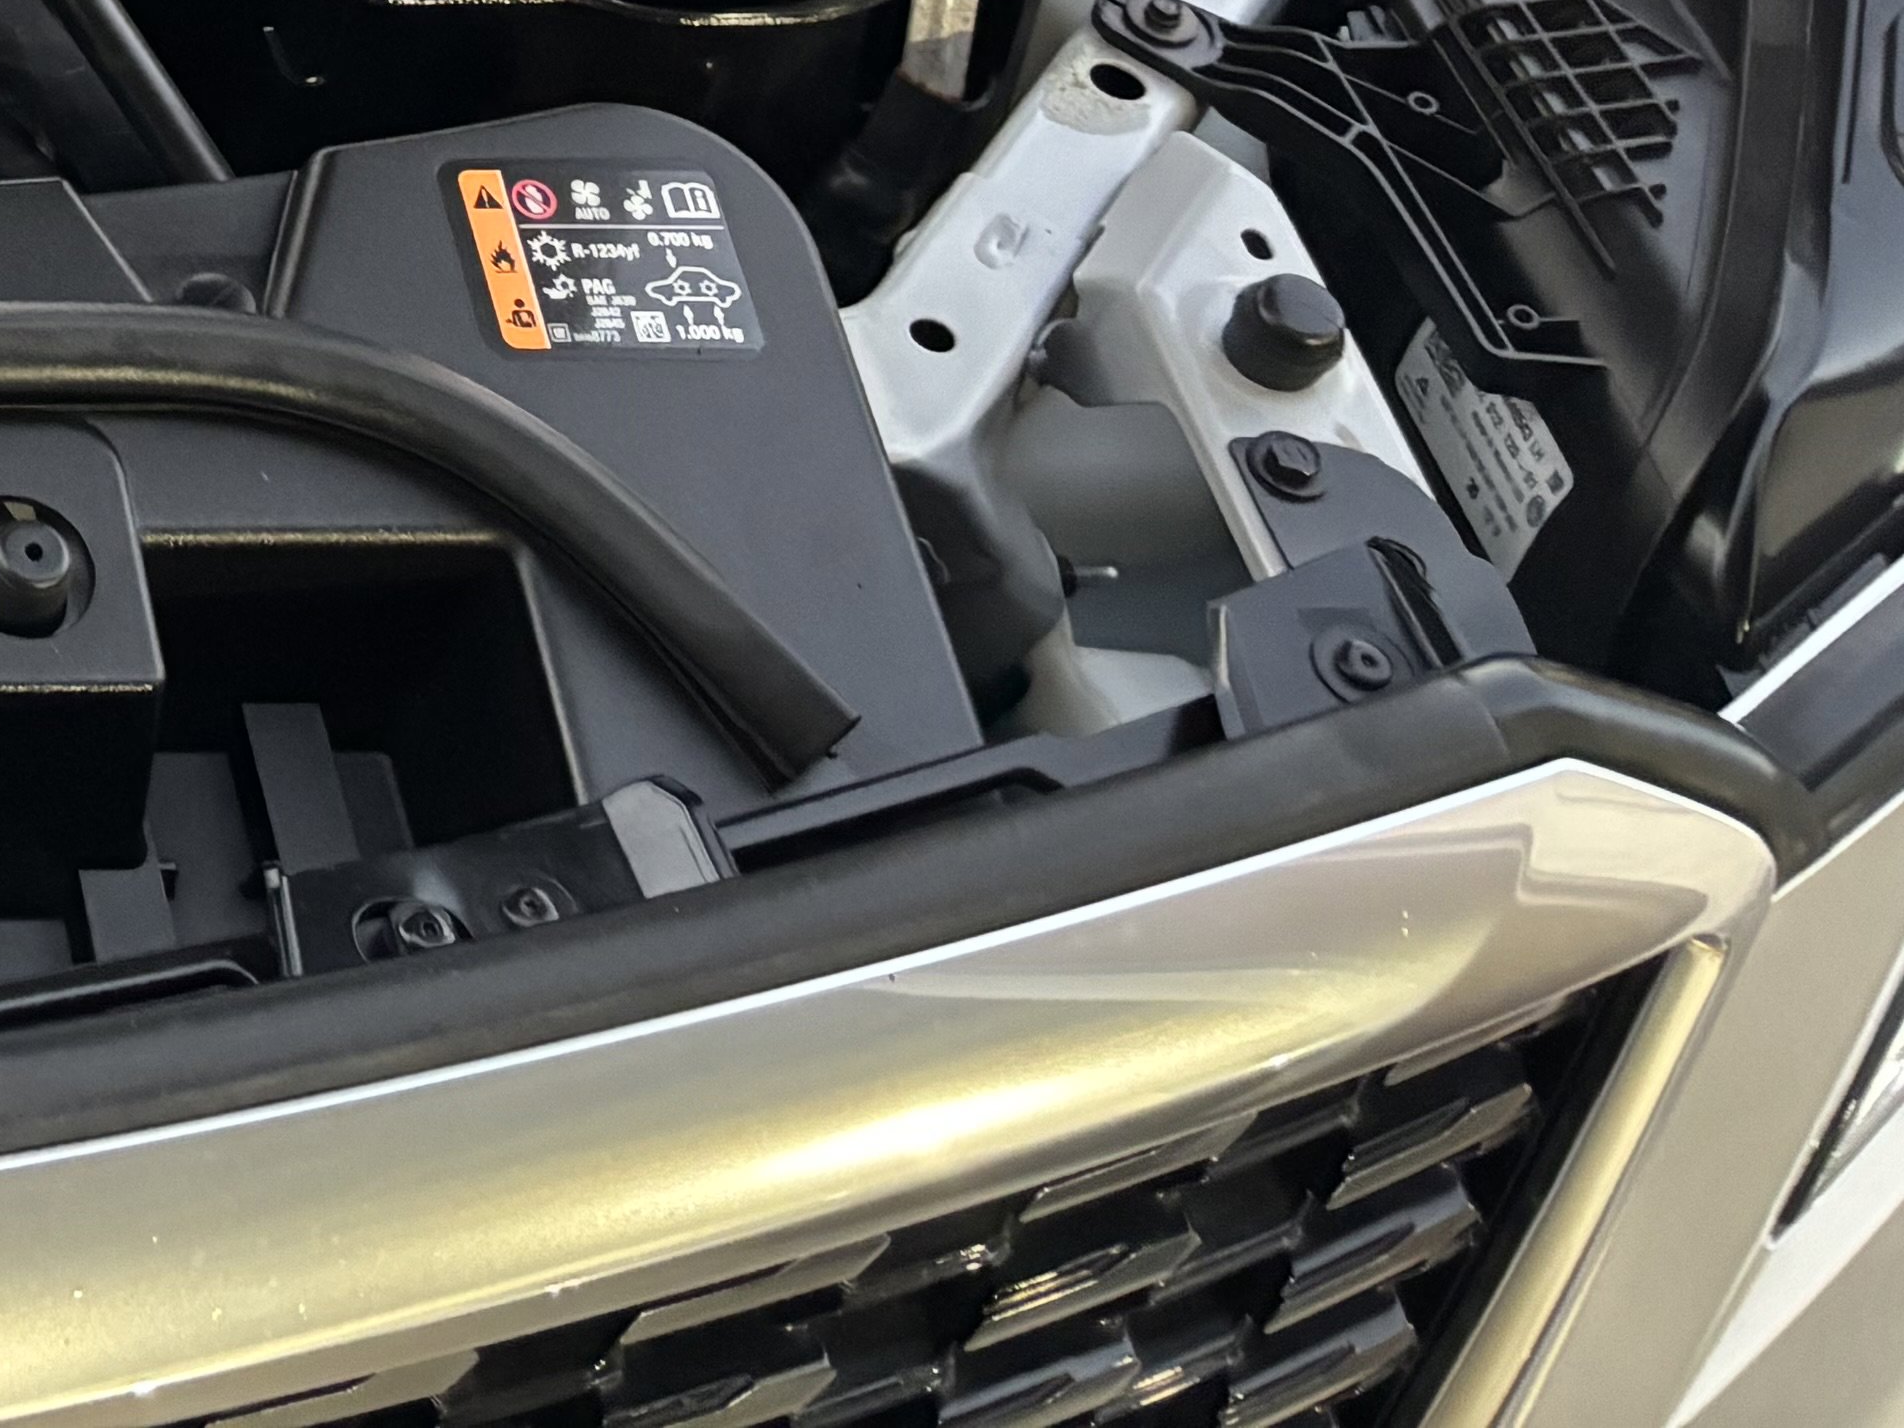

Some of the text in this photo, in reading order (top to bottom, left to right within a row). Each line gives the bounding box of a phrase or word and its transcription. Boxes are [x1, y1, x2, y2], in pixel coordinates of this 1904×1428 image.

[575, 207, 610, 221] AUTO
[571, 242, 641, 261] R-1234yf
[581, 278, 616, 295] PAG
